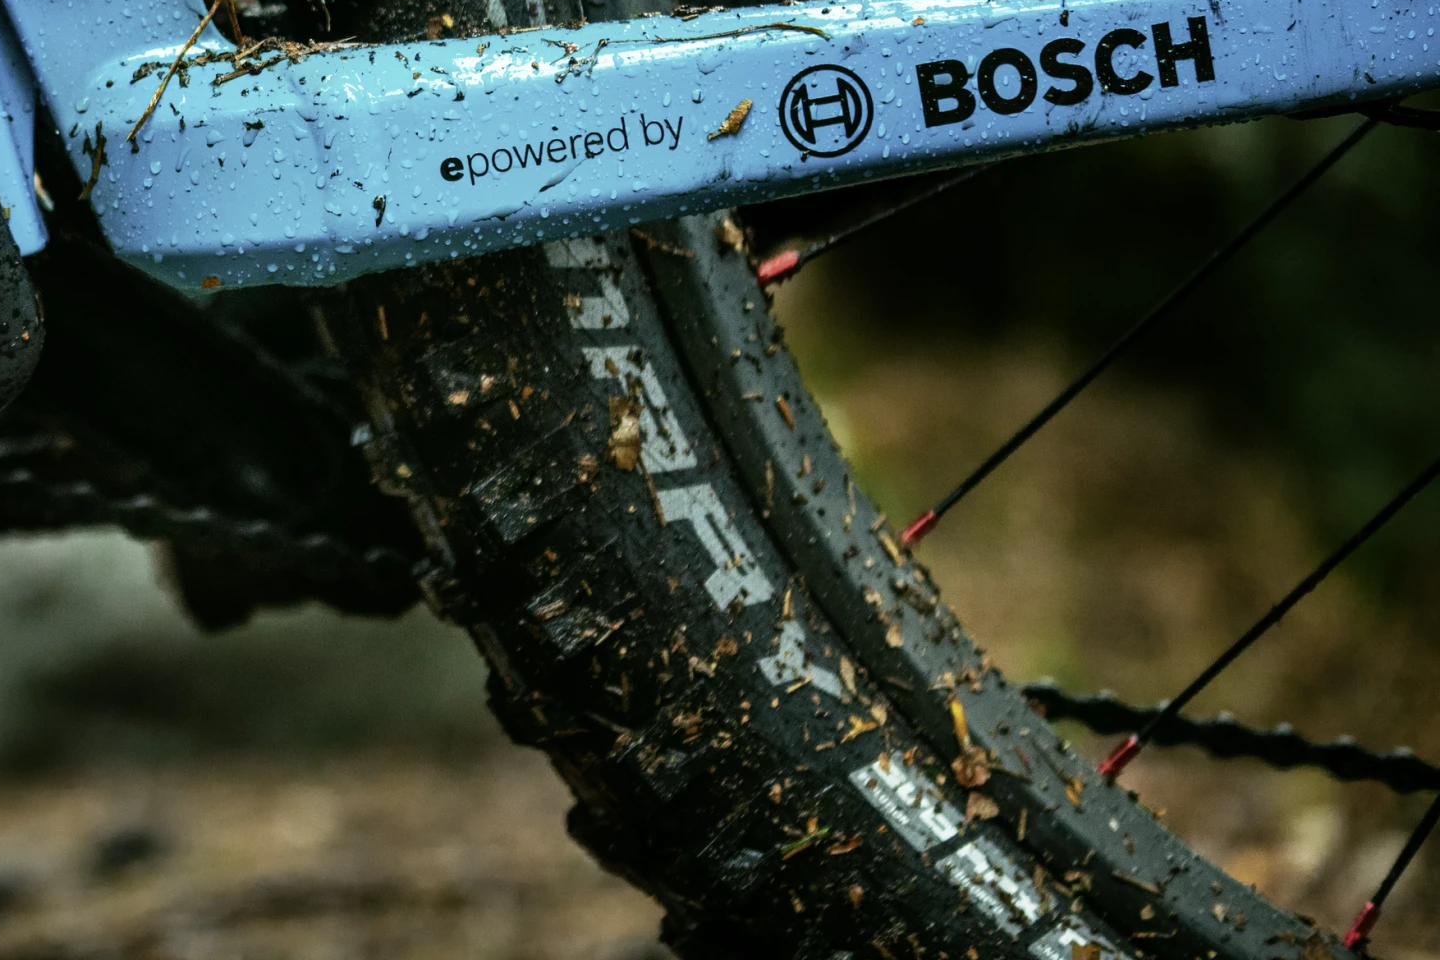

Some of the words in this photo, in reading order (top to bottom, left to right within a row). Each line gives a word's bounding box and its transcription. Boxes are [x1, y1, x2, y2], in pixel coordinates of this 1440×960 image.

[915, 14, 1217, 128] BOSCH
[440, 116, 630, 185] epowered
[640, 113, 684, 150] by
